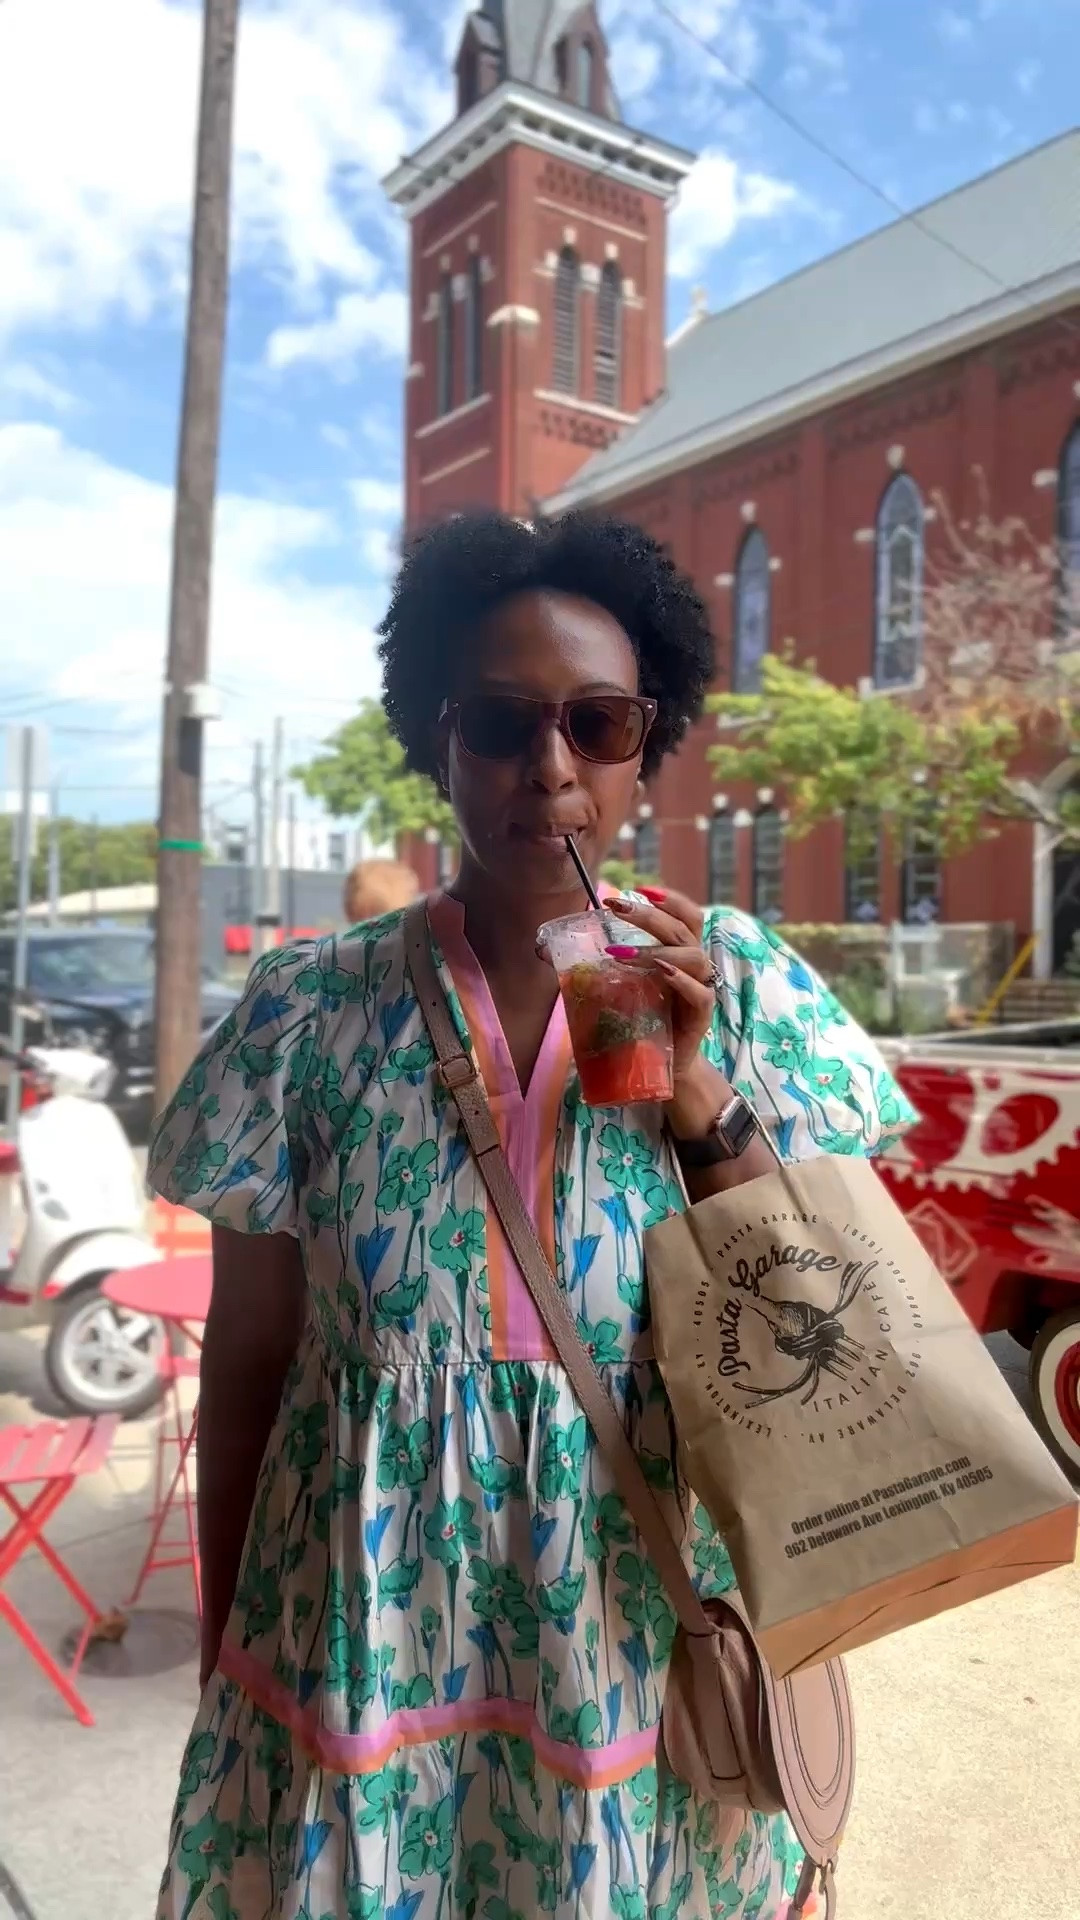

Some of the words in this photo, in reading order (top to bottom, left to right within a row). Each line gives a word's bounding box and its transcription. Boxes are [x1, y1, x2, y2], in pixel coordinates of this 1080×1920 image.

[717, 1223, 753, 1258] PASTA
[761, 1212, 818, 1225] GARAGE
[728, 1244, 842, 1297] Garage
[693, 1280, 709, 1328] 40505
[696, 1354, 706, 1369] KY
[717, 1297, 751, 1377] Pasta
[813, 1349, 889, 1412] ITALIAN
[863, 1281, 891, 1333] CAFÉ
[837, 1385, 907, 1439] DELAWARE
[784, 1540, 808, 1558] 962
[807, 1520, 862, 1549] Delaware
[861, 1511, 883, 1528] Ave
[939, 1483, 956, 1497] Ky
[955, 1465, 994, 1490] 40505
[791, 1513, 823, 1535] Order
[824, 1500, 861, 1522] online
[861, 1493, 874, 1508] at
[872, 1456, 971, 1502] PastaGarage.com
